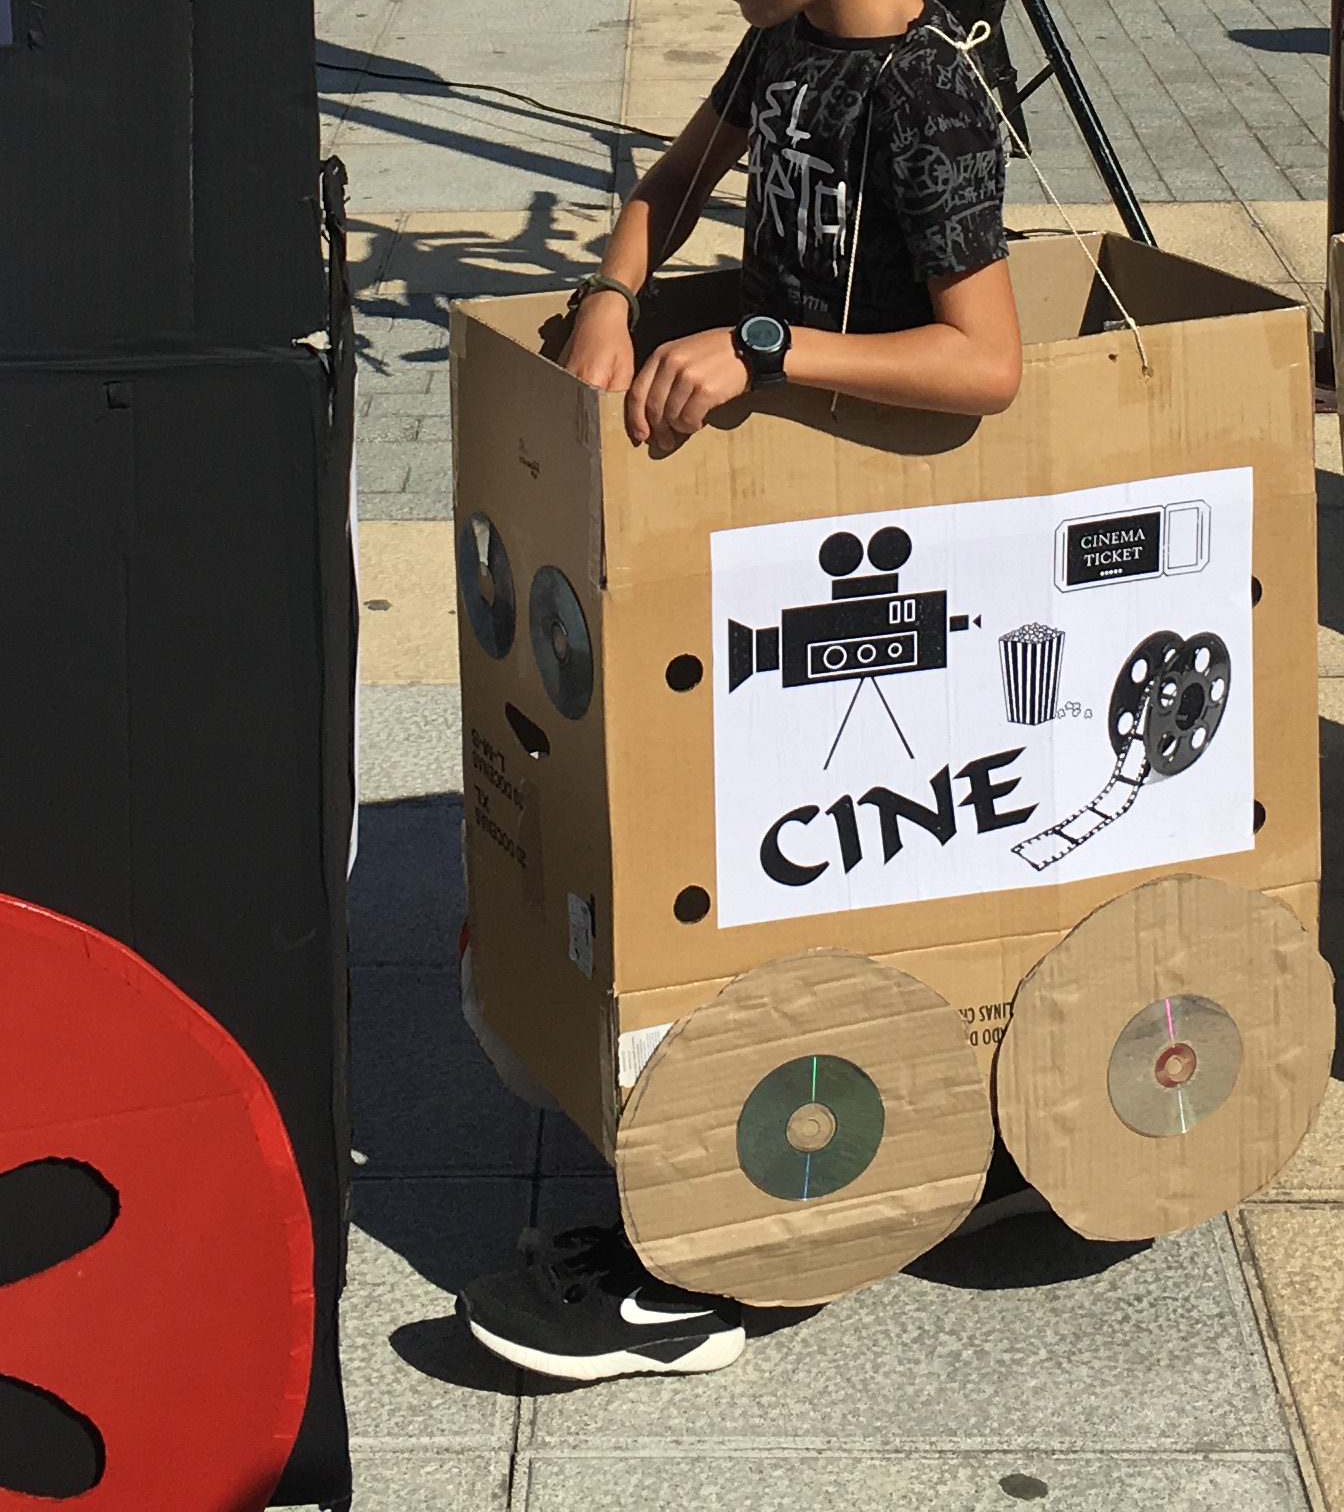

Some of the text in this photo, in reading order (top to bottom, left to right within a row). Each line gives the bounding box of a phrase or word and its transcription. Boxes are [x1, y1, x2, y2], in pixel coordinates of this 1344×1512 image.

[1080, 528, 1146, 549] CINEMA
[1083, 546, 1143, 567] TICKET
[759, 745, 1041, 887] CINE
[979, 1002, 1013, 1023] LINAS
